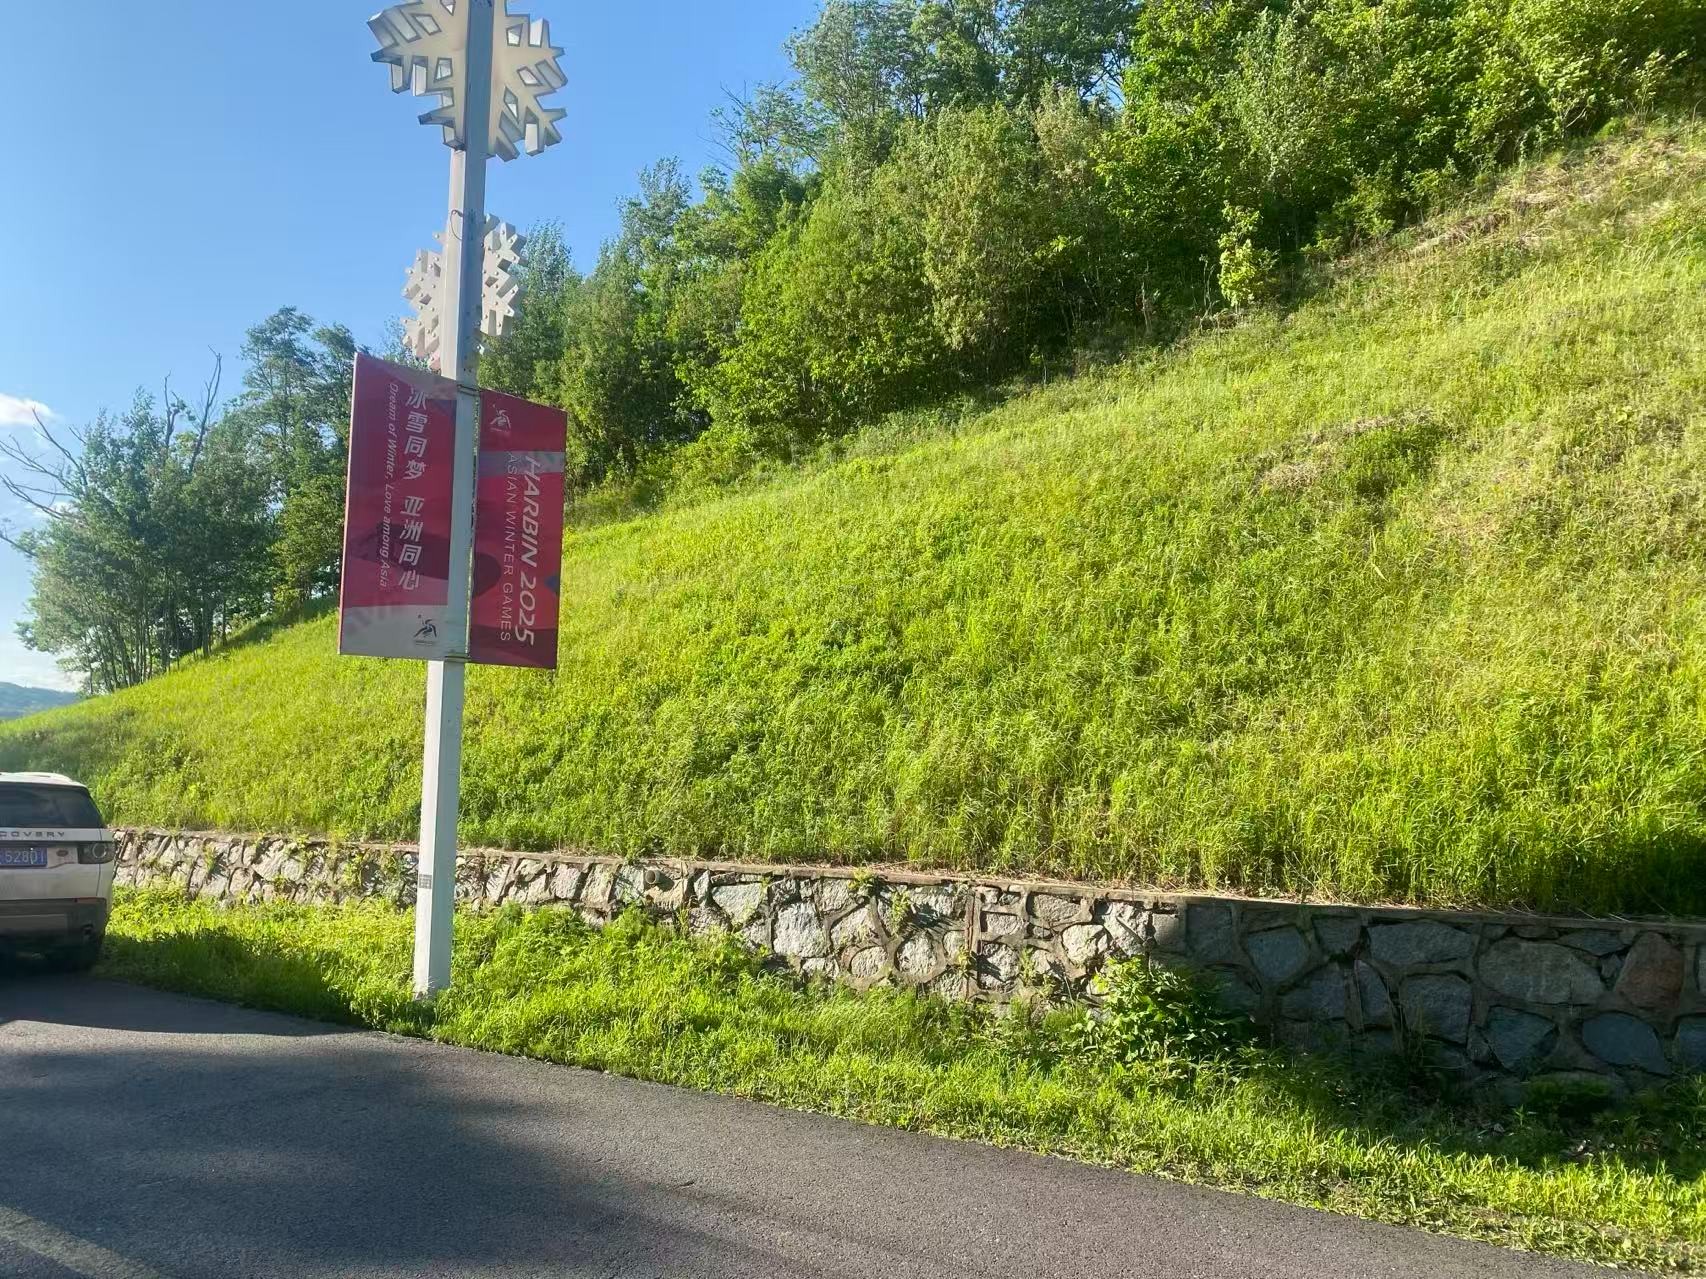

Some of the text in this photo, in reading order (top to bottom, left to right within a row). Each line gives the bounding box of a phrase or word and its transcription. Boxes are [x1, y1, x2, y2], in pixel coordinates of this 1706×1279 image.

[379, 383, 399, 587] Dream of Winter, Love among Asia
[398, 384, 428, 591] 冰雪同梦 亚洲同心
[500, 451, 520, 641] ASIAN WINTER GAMES
[515, 455, 541, 646] HARBIN 2025
